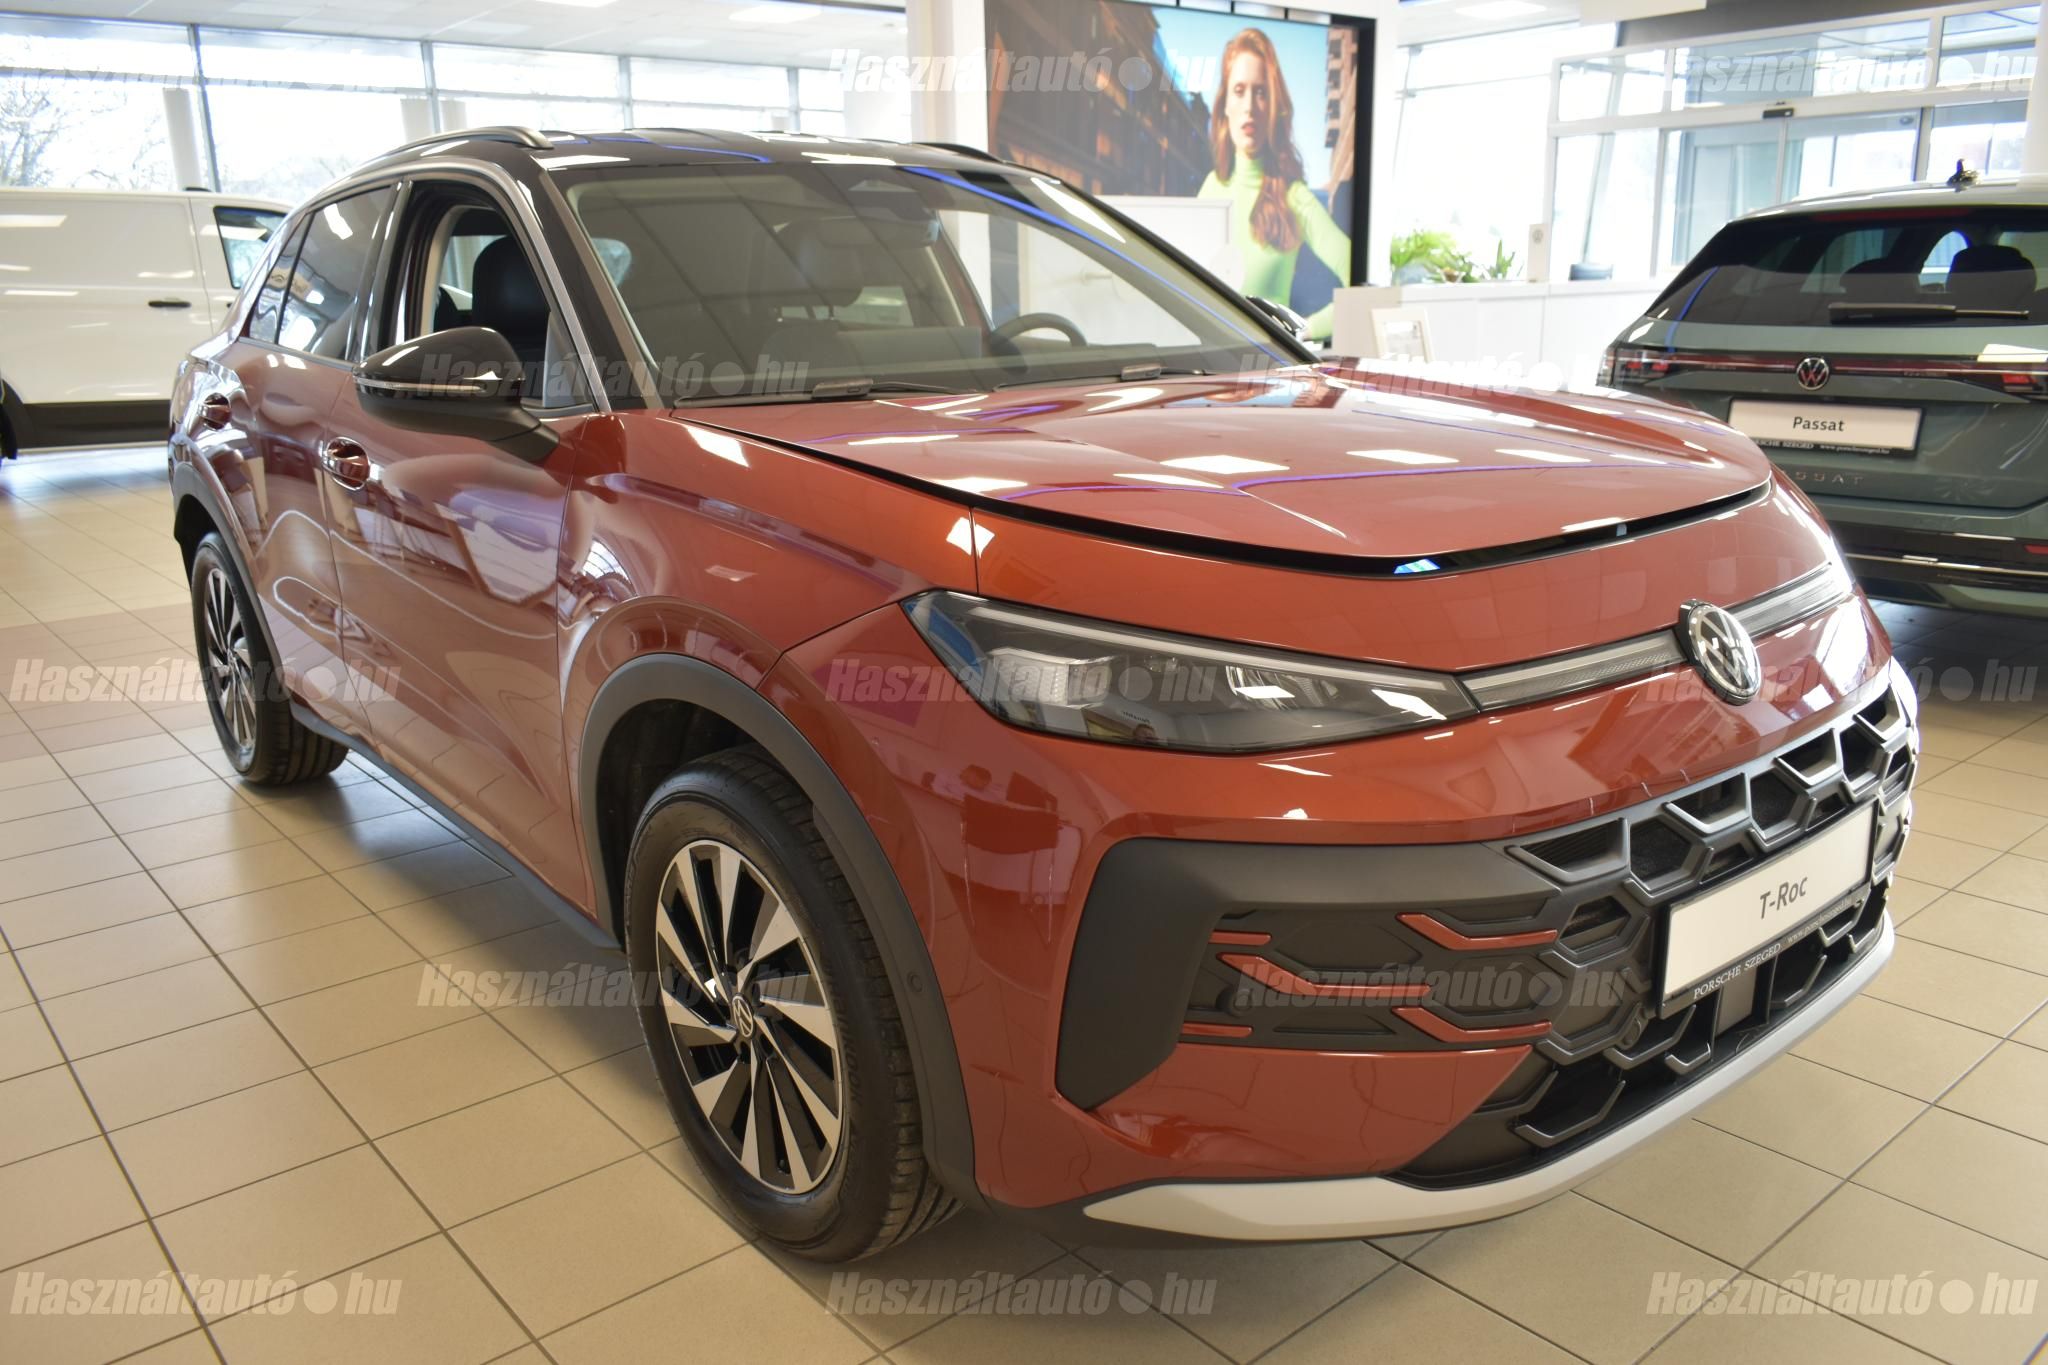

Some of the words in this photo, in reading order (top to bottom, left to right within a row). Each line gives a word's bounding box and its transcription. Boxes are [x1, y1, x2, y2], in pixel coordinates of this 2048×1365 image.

[1793, 416, 1845, 432] Passat
[1795, 472, 1864, 485] SSAT
[1760, 877, 1808, 919] T-Roc
[1693, 965, 1742, 1000] PORSCHE
[1743, 942, 1782, 971] SZEGED
